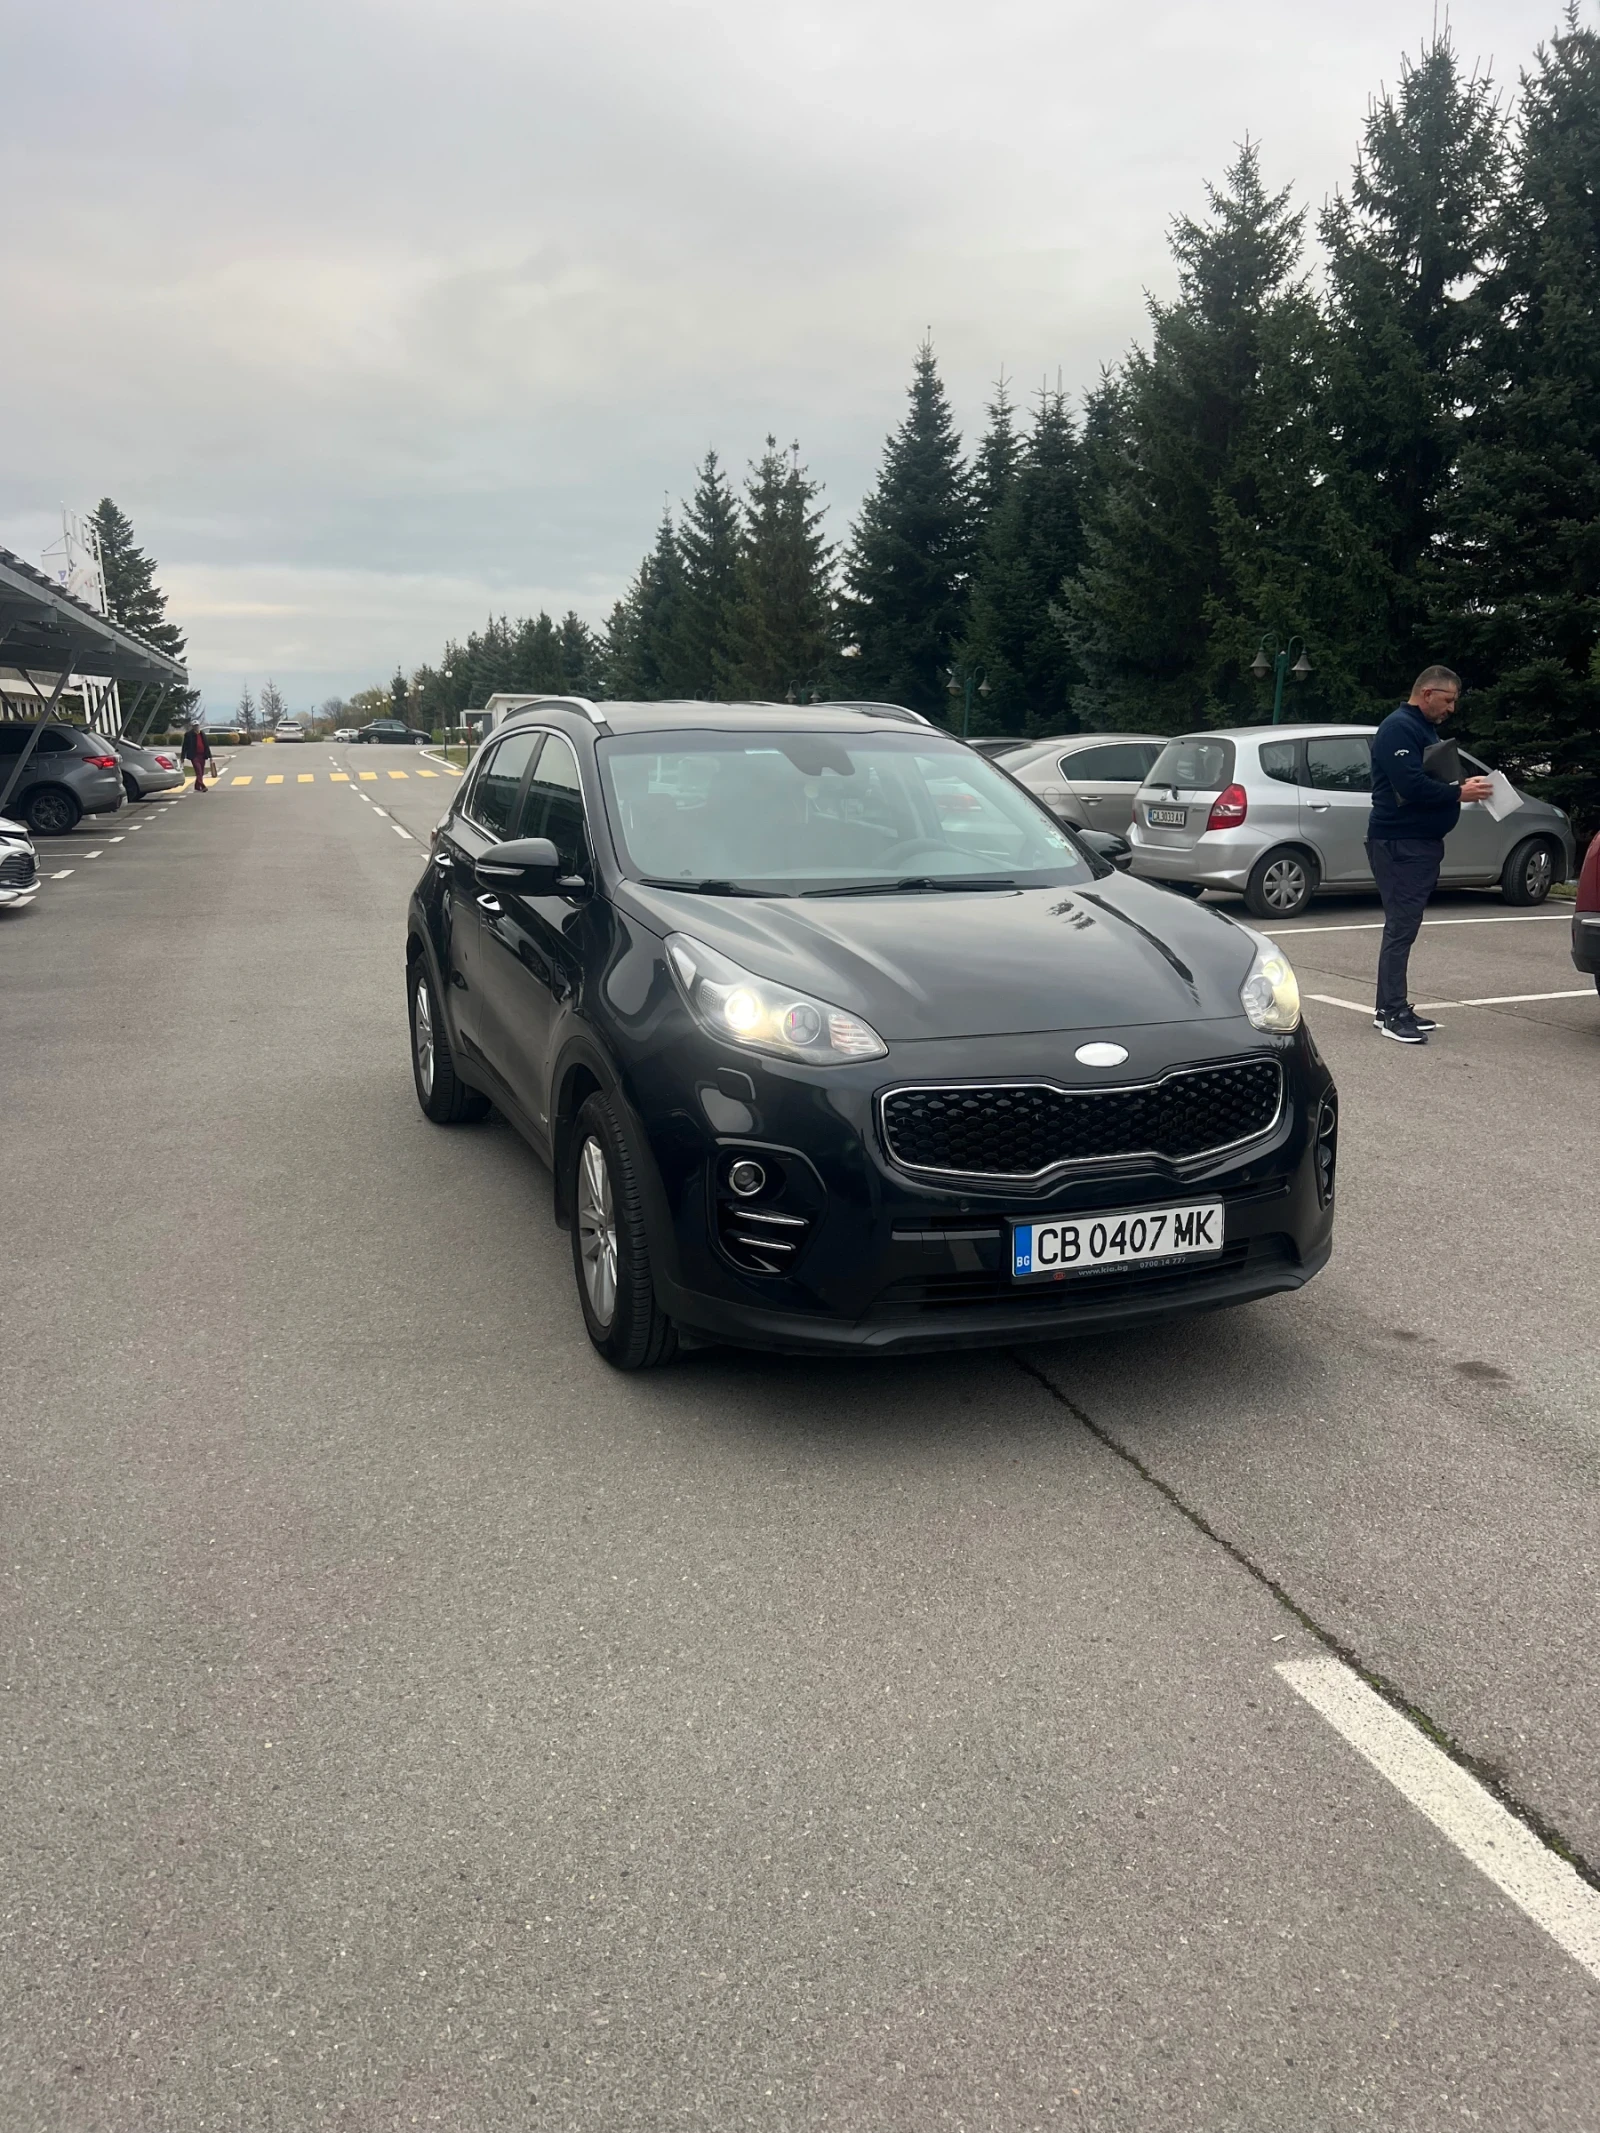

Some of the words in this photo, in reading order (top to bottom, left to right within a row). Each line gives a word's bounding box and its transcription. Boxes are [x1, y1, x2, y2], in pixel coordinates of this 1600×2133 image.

[1038, 1226, 1080, 1264] CB
[1090, 1215, 1167, 1258] 0407
[1174, 1210, 1214, 1248] MK
[1016, 1256, 1030, 1267] BG
[1078, 1264, 1129, 1276] www.kia.bg
[1140, 1260, 1158, 1269] 0700
